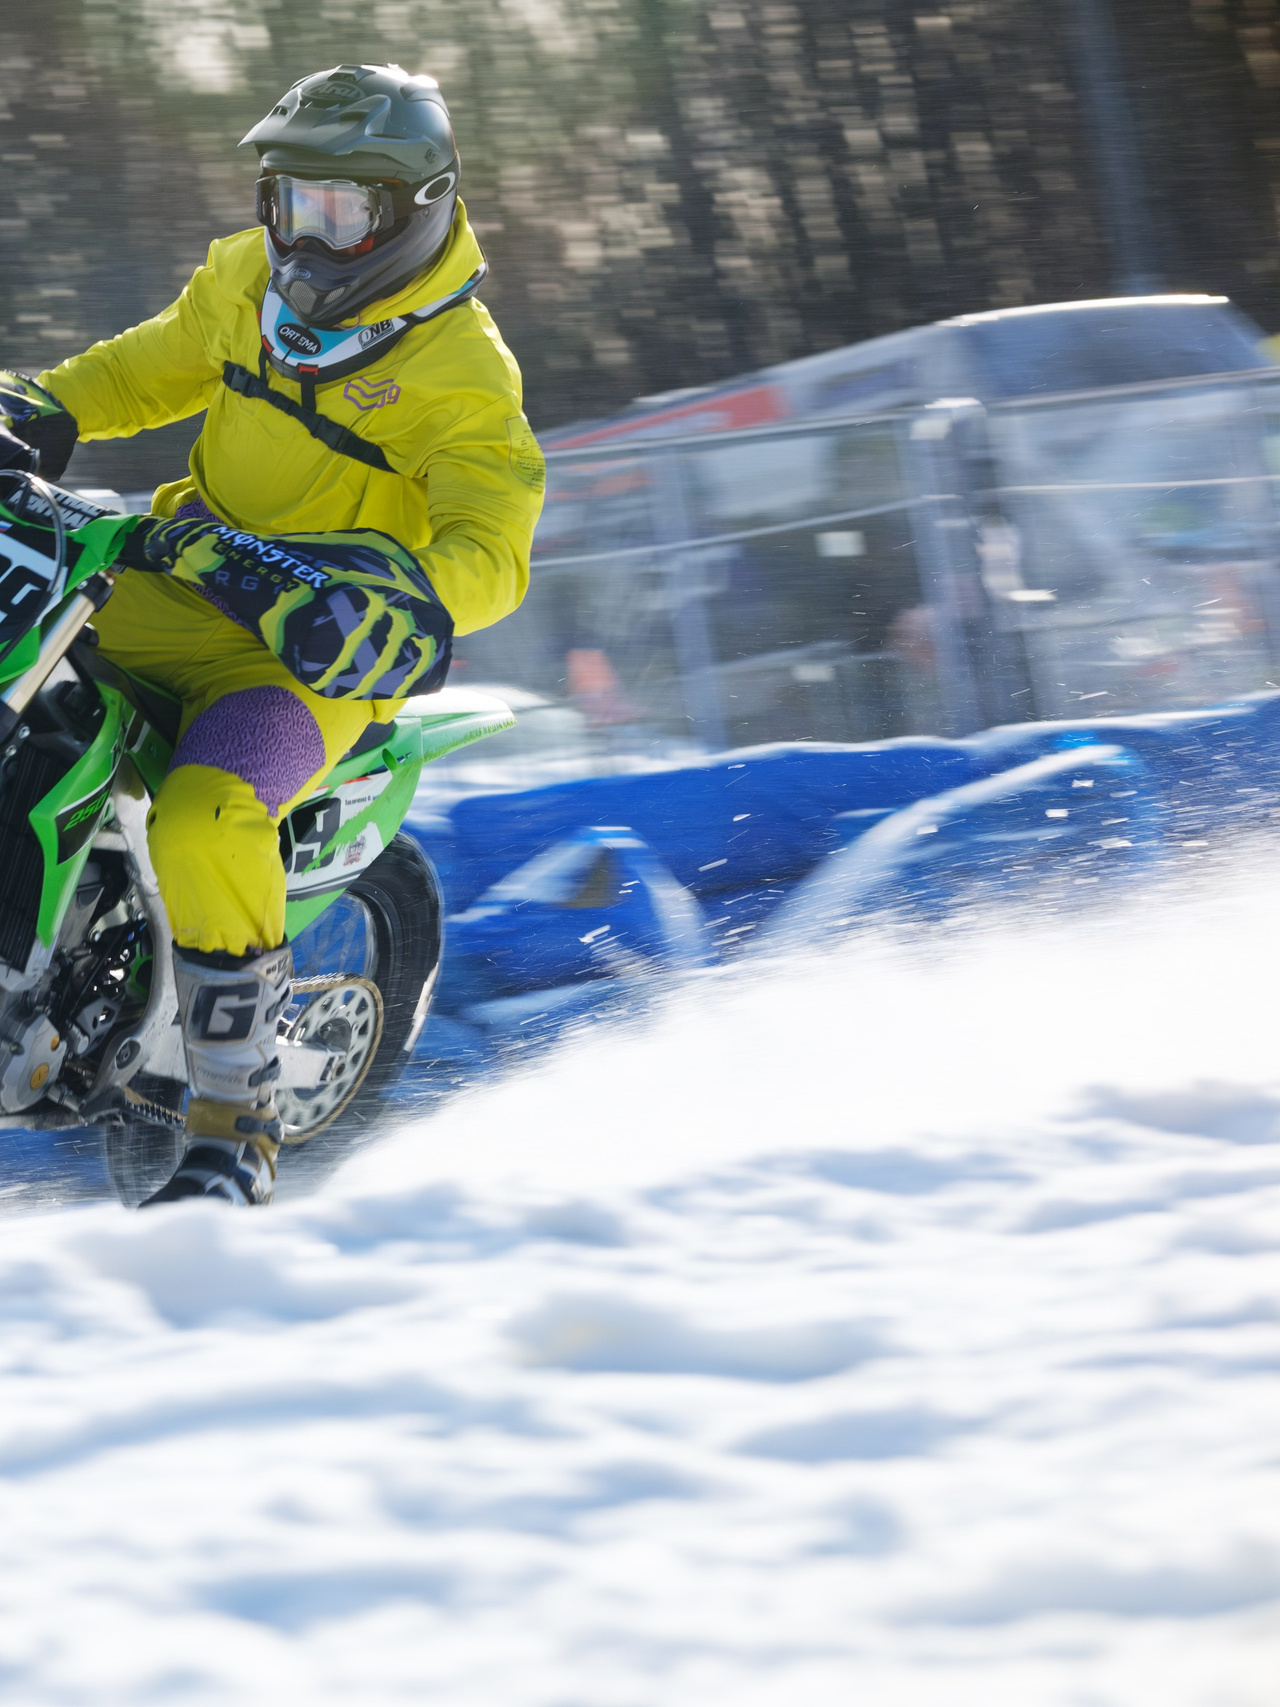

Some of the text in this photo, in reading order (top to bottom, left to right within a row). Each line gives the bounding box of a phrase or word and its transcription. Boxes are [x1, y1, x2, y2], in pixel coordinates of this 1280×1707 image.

[280, 326, 319, 353] ORTEMA
[213, 526, 329, 589] MONSTER
[63, 788, 110, 832] 250
[278, 796, 342, 875] 9
[188, 980, 261, 1042] G
